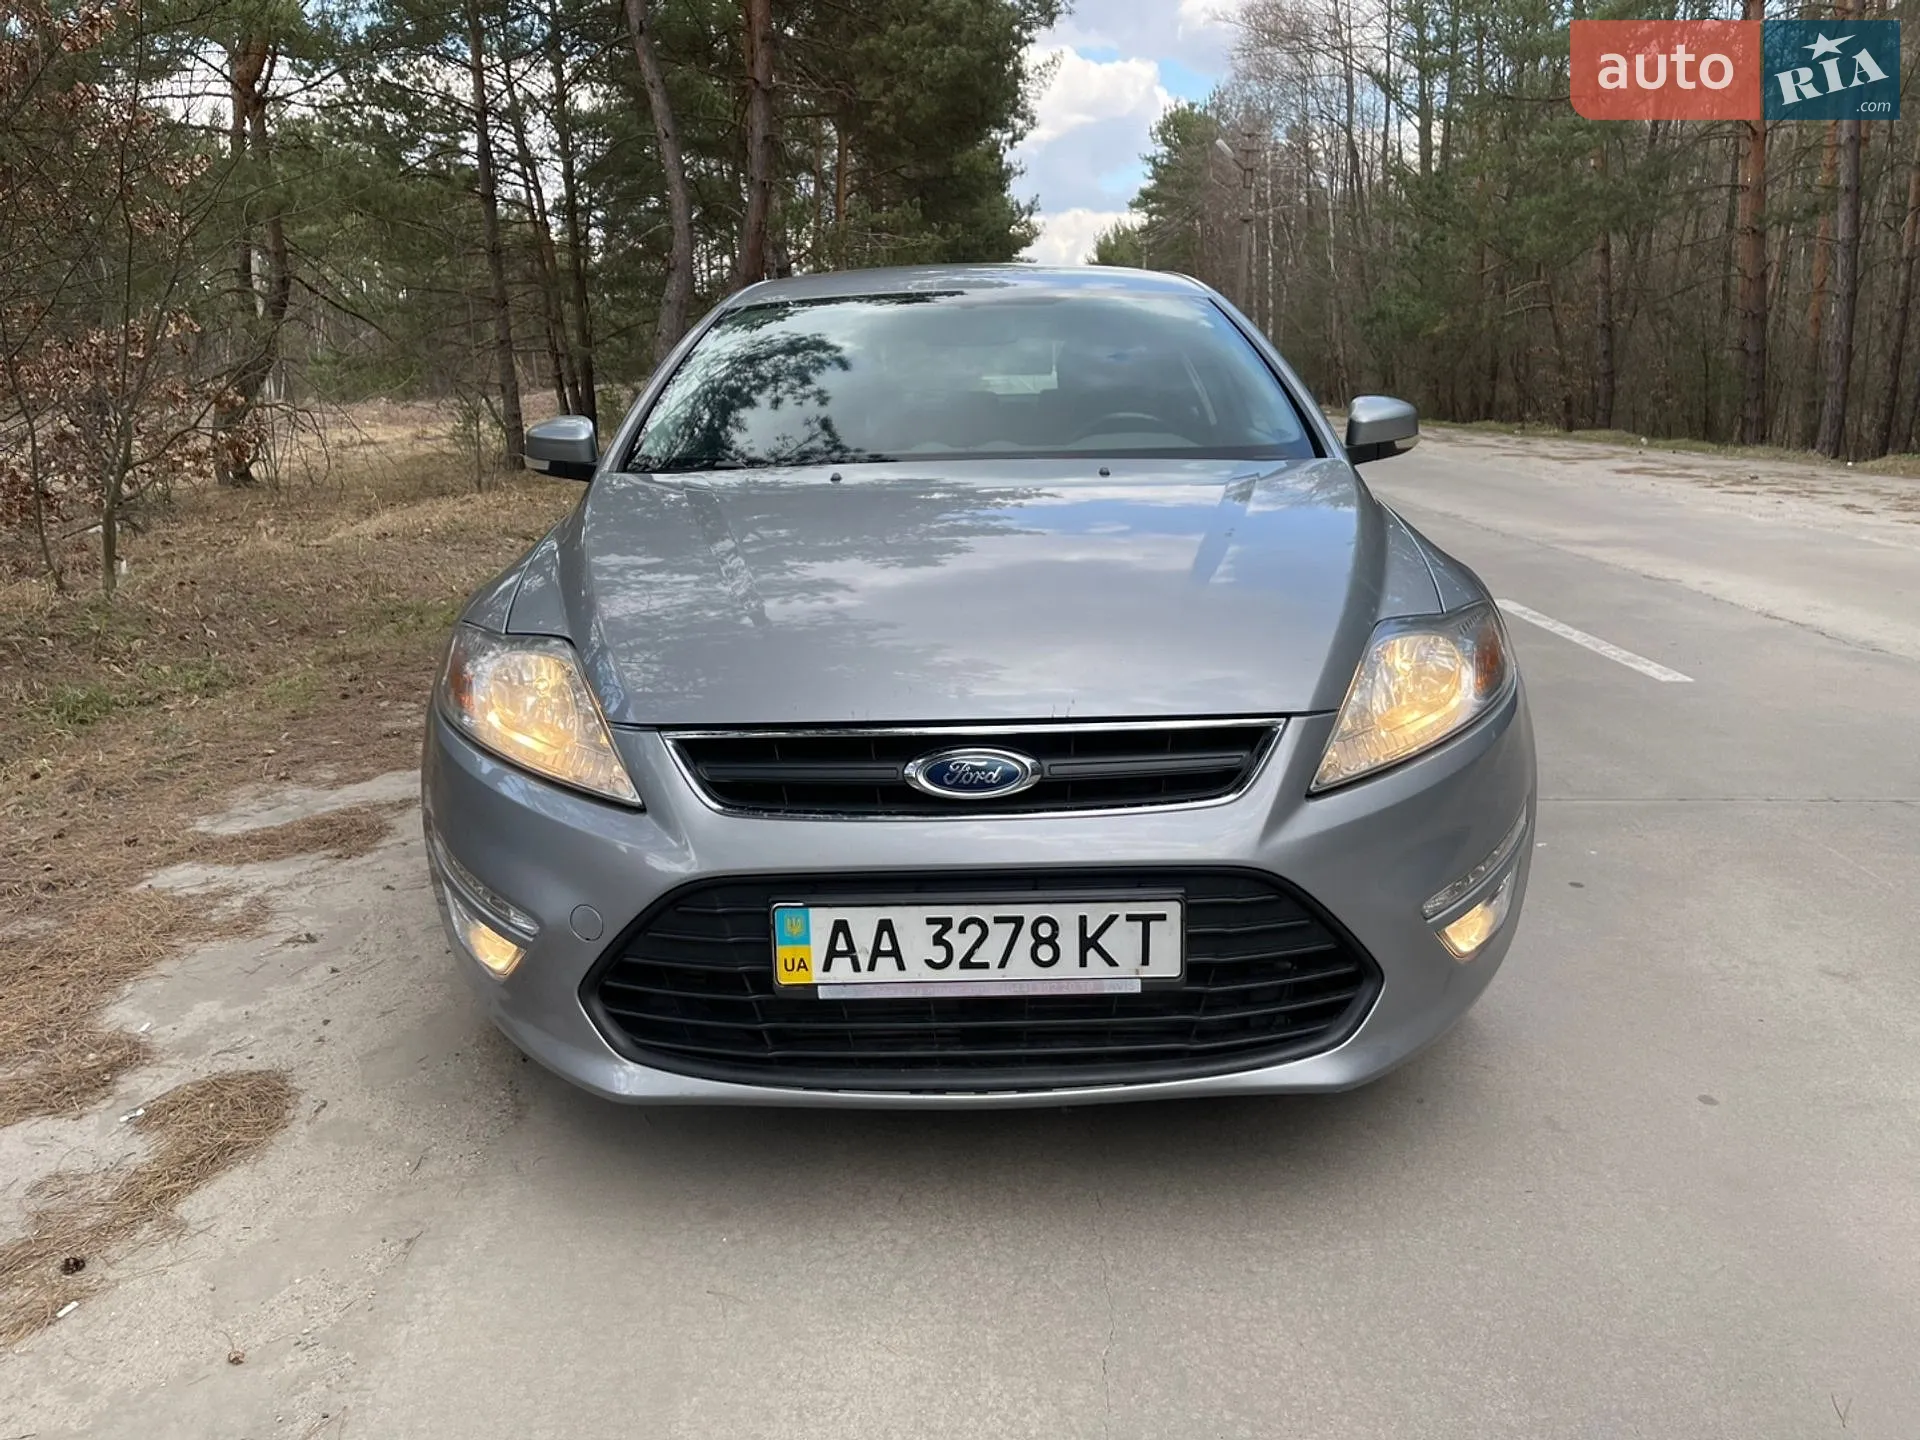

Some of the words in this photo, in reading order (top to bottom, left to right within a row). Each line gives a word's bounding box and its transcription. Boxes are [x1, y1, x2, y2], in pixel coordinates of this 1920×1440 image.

[943, 760, 1003, 785] Ford
[822, 918, 907, 973] AA
[923, 916, 1061, 971] 3278
[1078, 912, 1168, 968] KT
[783, 958, 809, 973] UA
